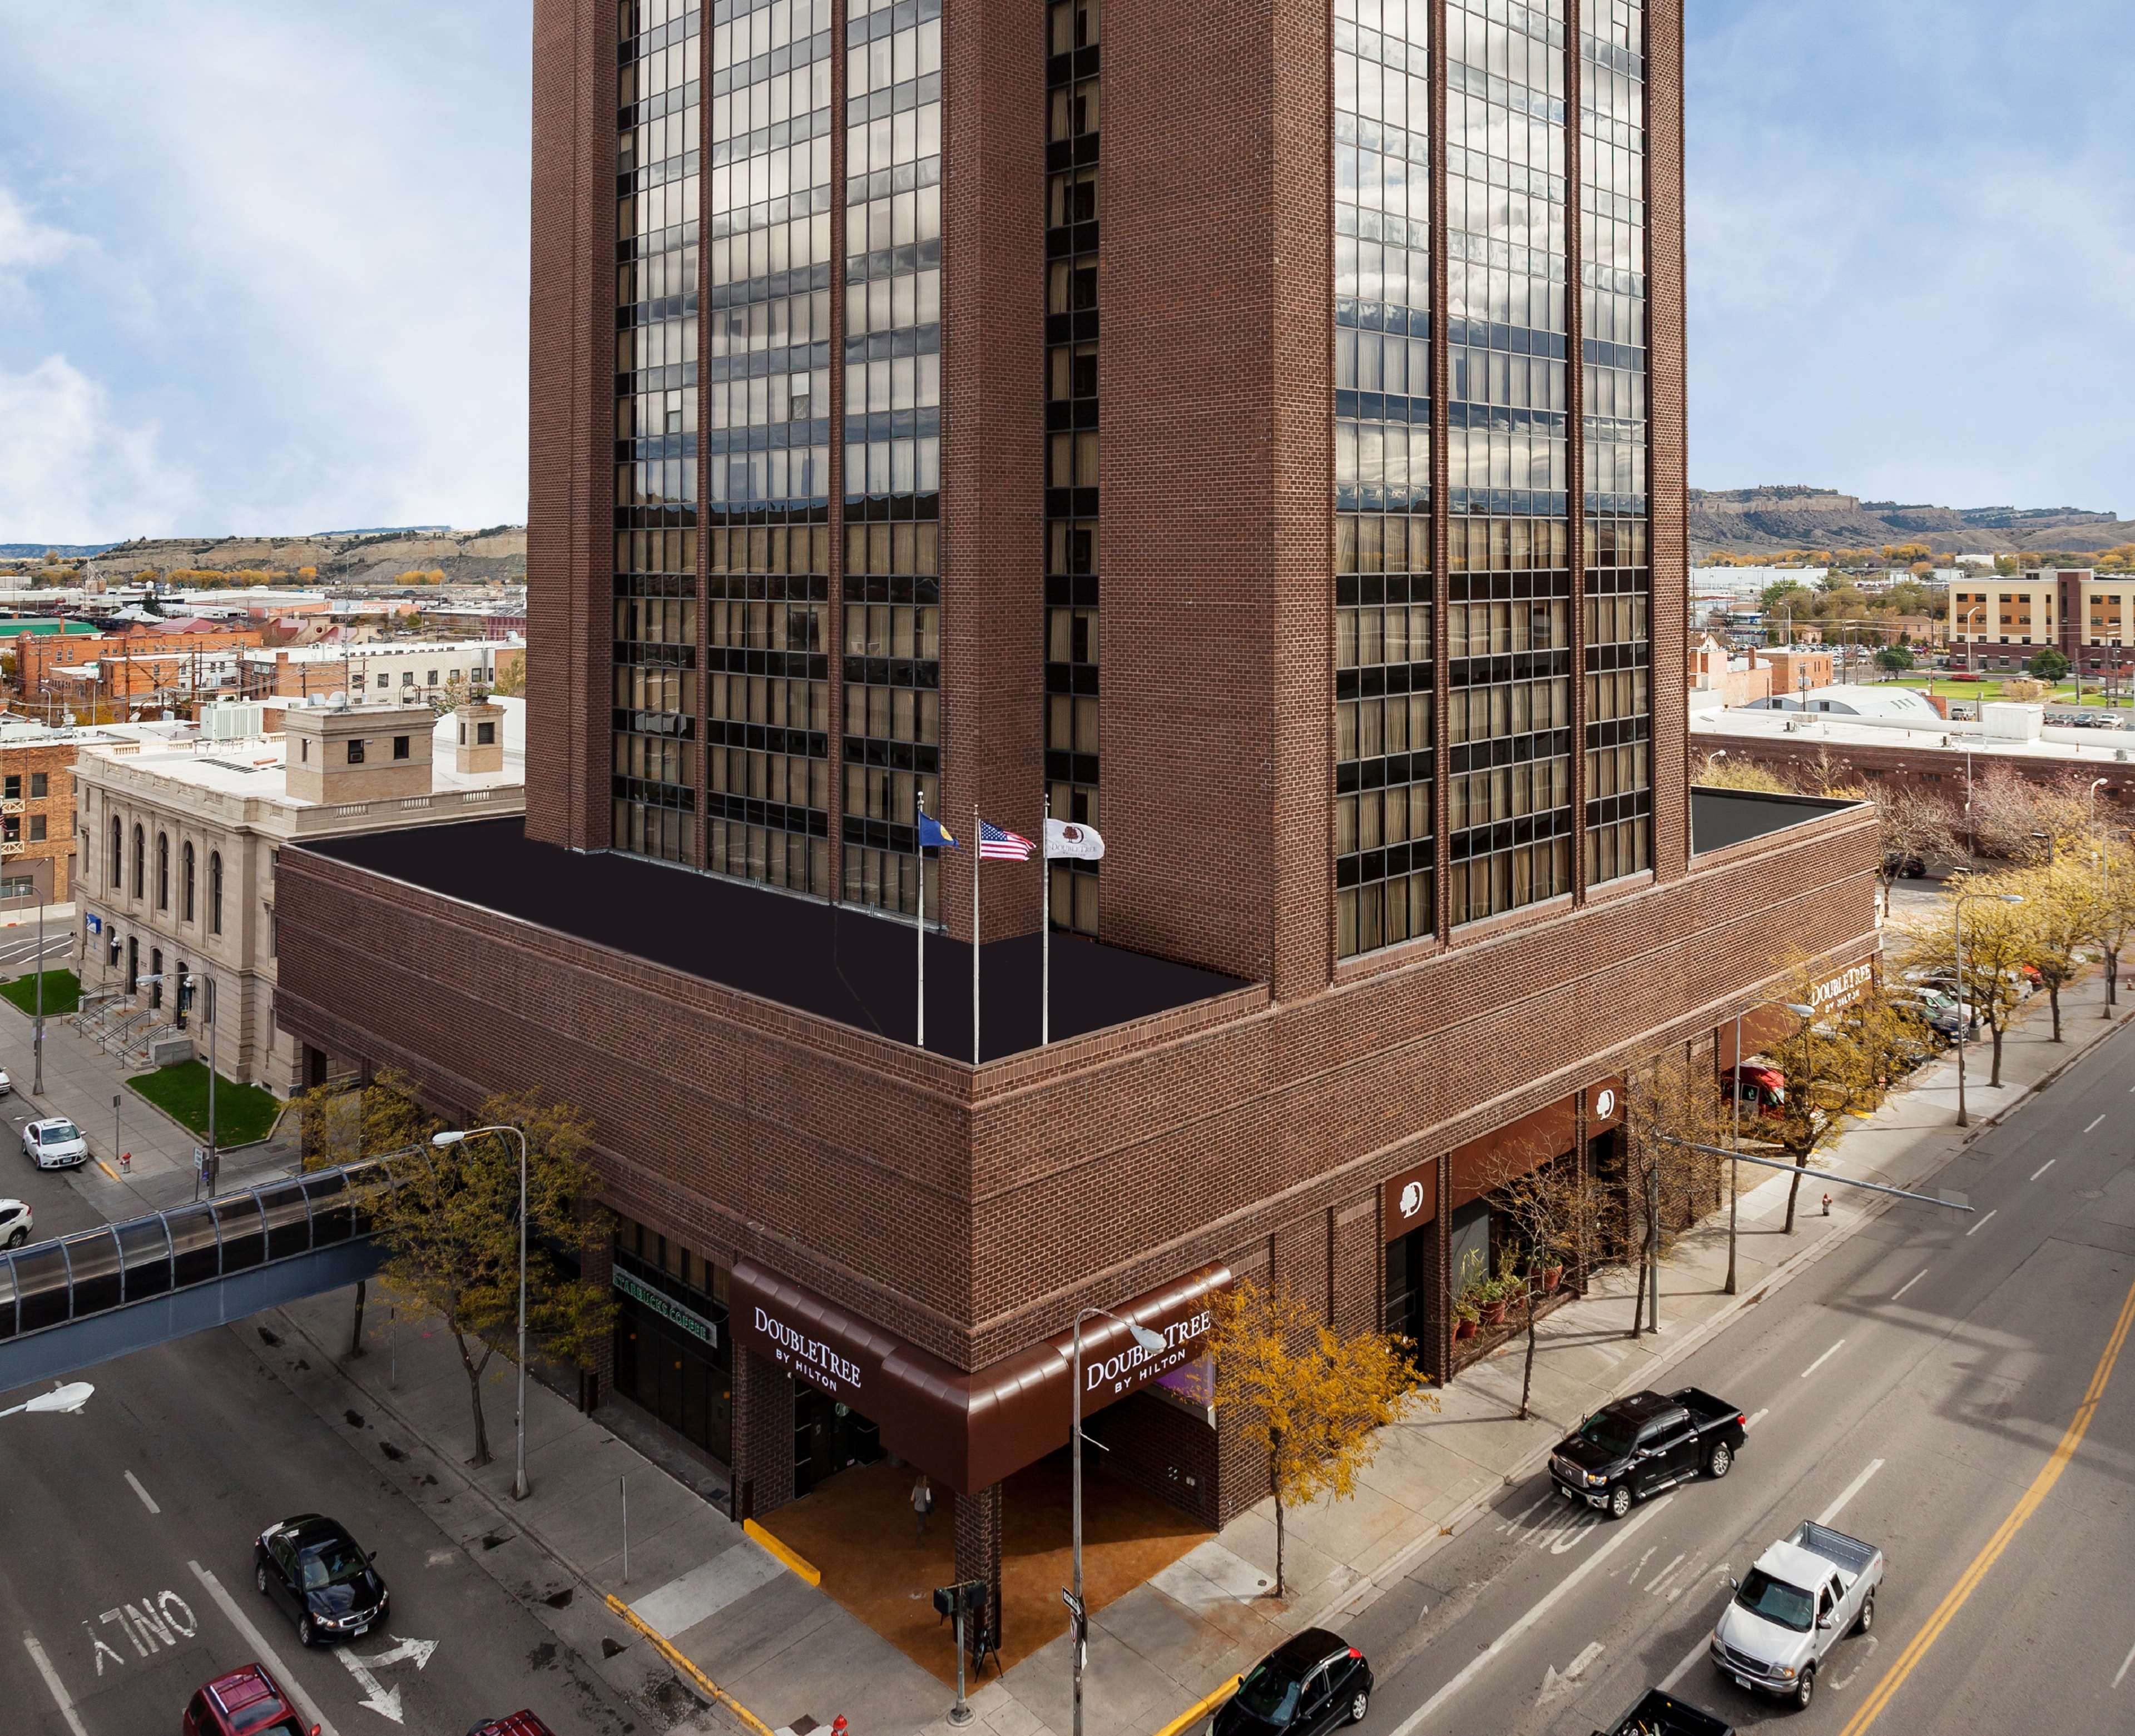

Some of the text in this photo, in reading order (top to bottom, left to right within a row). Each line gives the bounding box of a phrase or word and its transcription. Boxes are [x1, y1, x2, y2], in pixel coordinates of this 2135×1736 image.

[1811, 963, 1871, 1006] DOUBLETREE
[613, 1274, 707, 1340] STARBUCKS COFFEE
[755, 1307, 861, 1388] DOUBLETREE
[776, 1348, 836, 1391] BY HILTON
[1086, 1310, 1211, 1391] DOUBLTREE
[1114, 1348, 1186, 1393] BY HILTON
[82, 1590, 198, 1677] ONLY
